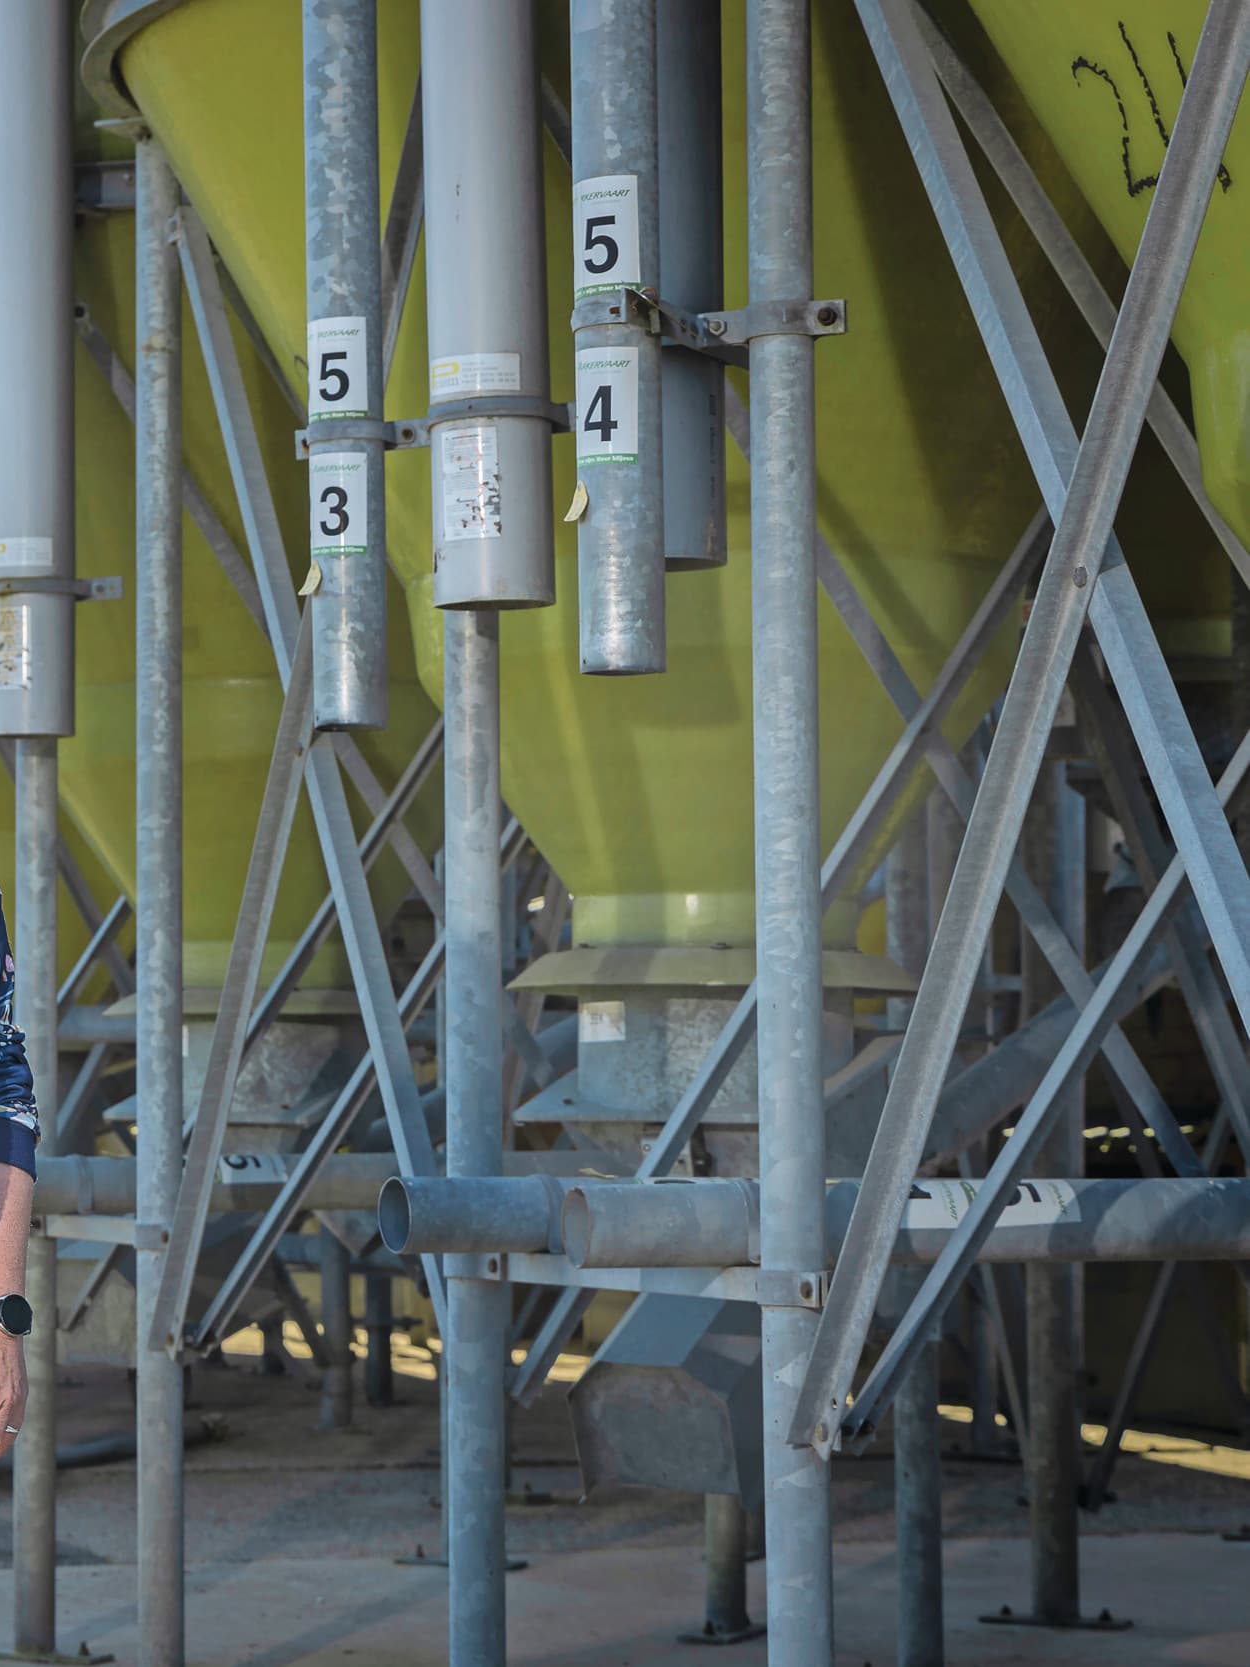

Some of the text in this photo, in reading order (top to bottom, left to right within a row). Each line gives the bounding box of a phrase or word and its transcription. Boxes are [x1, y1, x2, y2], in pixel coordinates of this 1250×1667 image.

[583, 215, 619, 274] 5
[318, 351, 350, 402] 5
[584, 385, 618, 442] 4
[319, 486, 350, 537] 3
